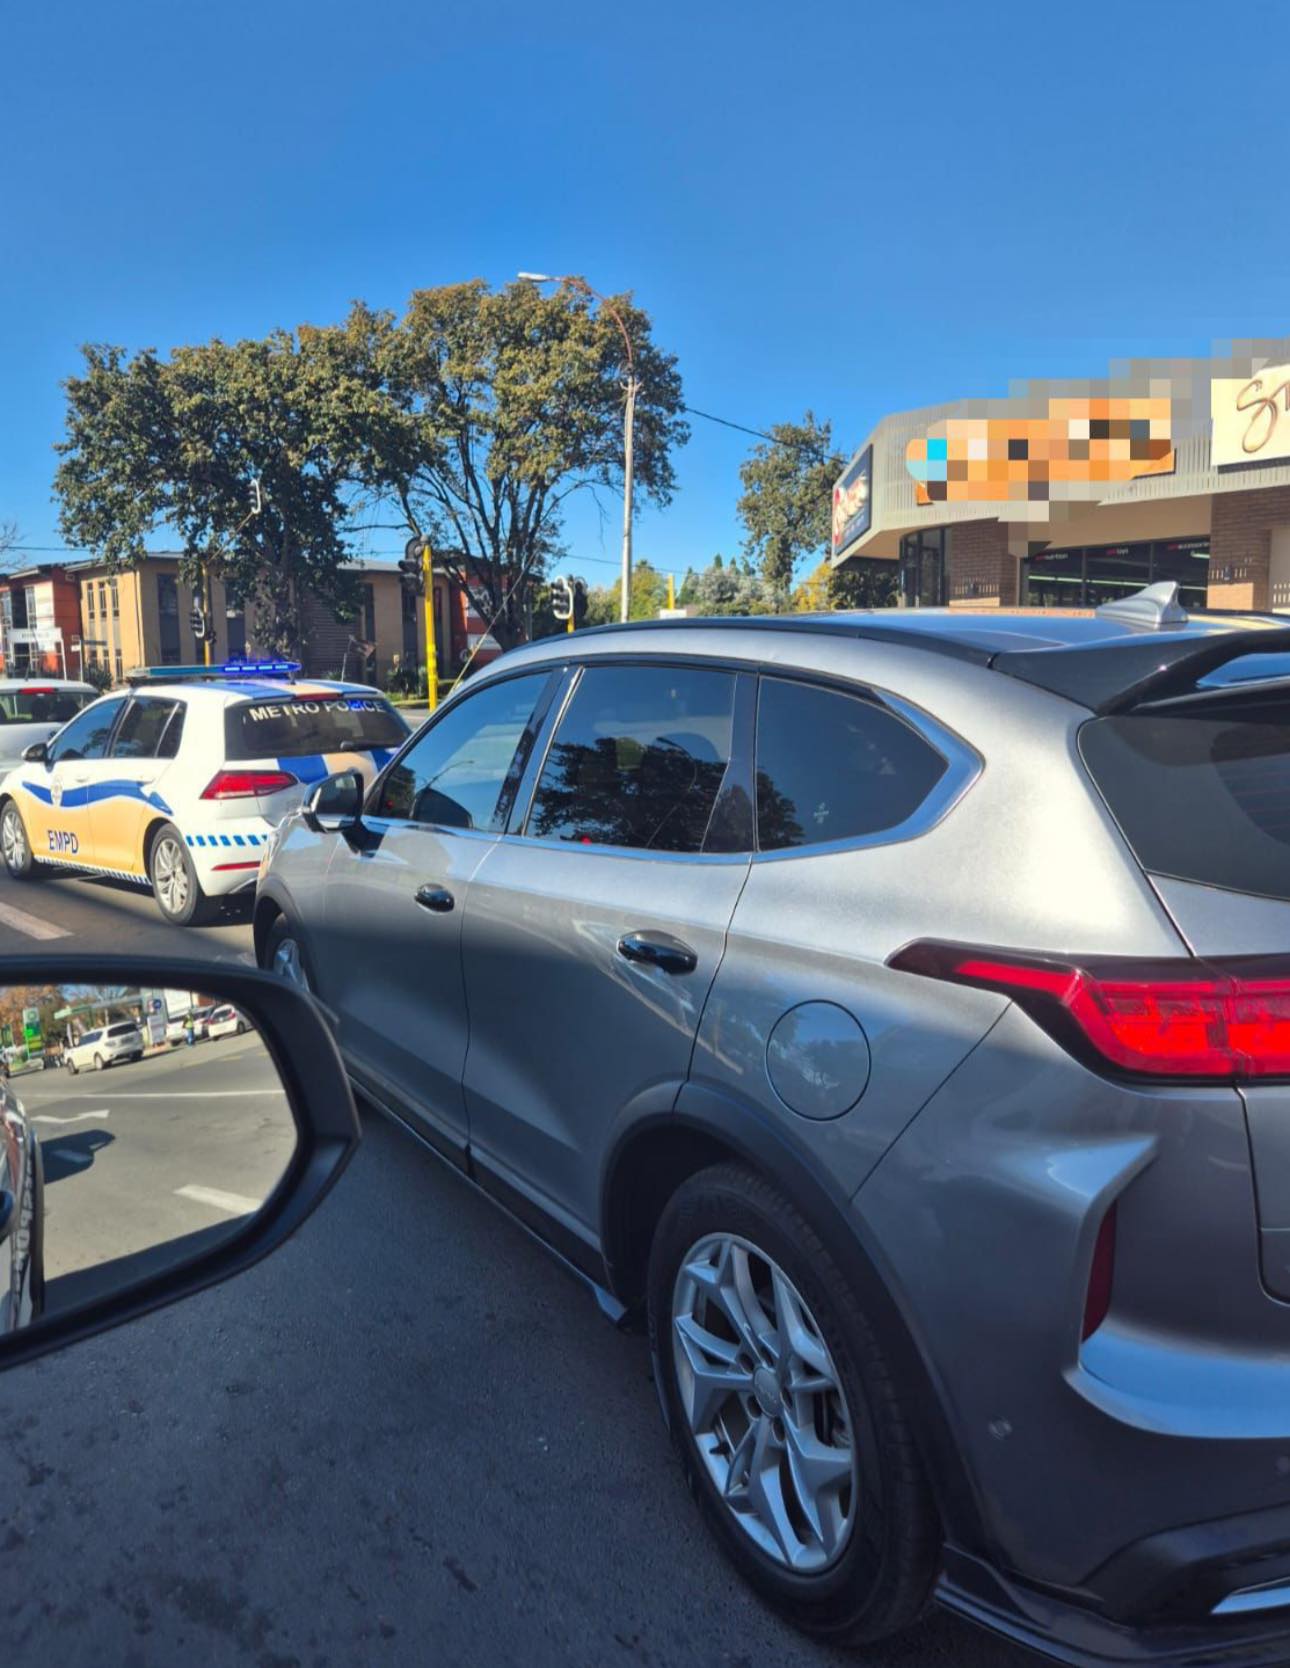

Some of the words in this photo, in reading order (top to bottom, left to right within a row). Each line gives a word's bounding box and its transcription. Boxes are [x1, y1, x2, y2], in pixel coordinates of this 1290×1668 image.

[249, 701, 320, 721] METRO
[323, 700, 387, 713] POLICE
[48, 829, 79, 854] EMPD
